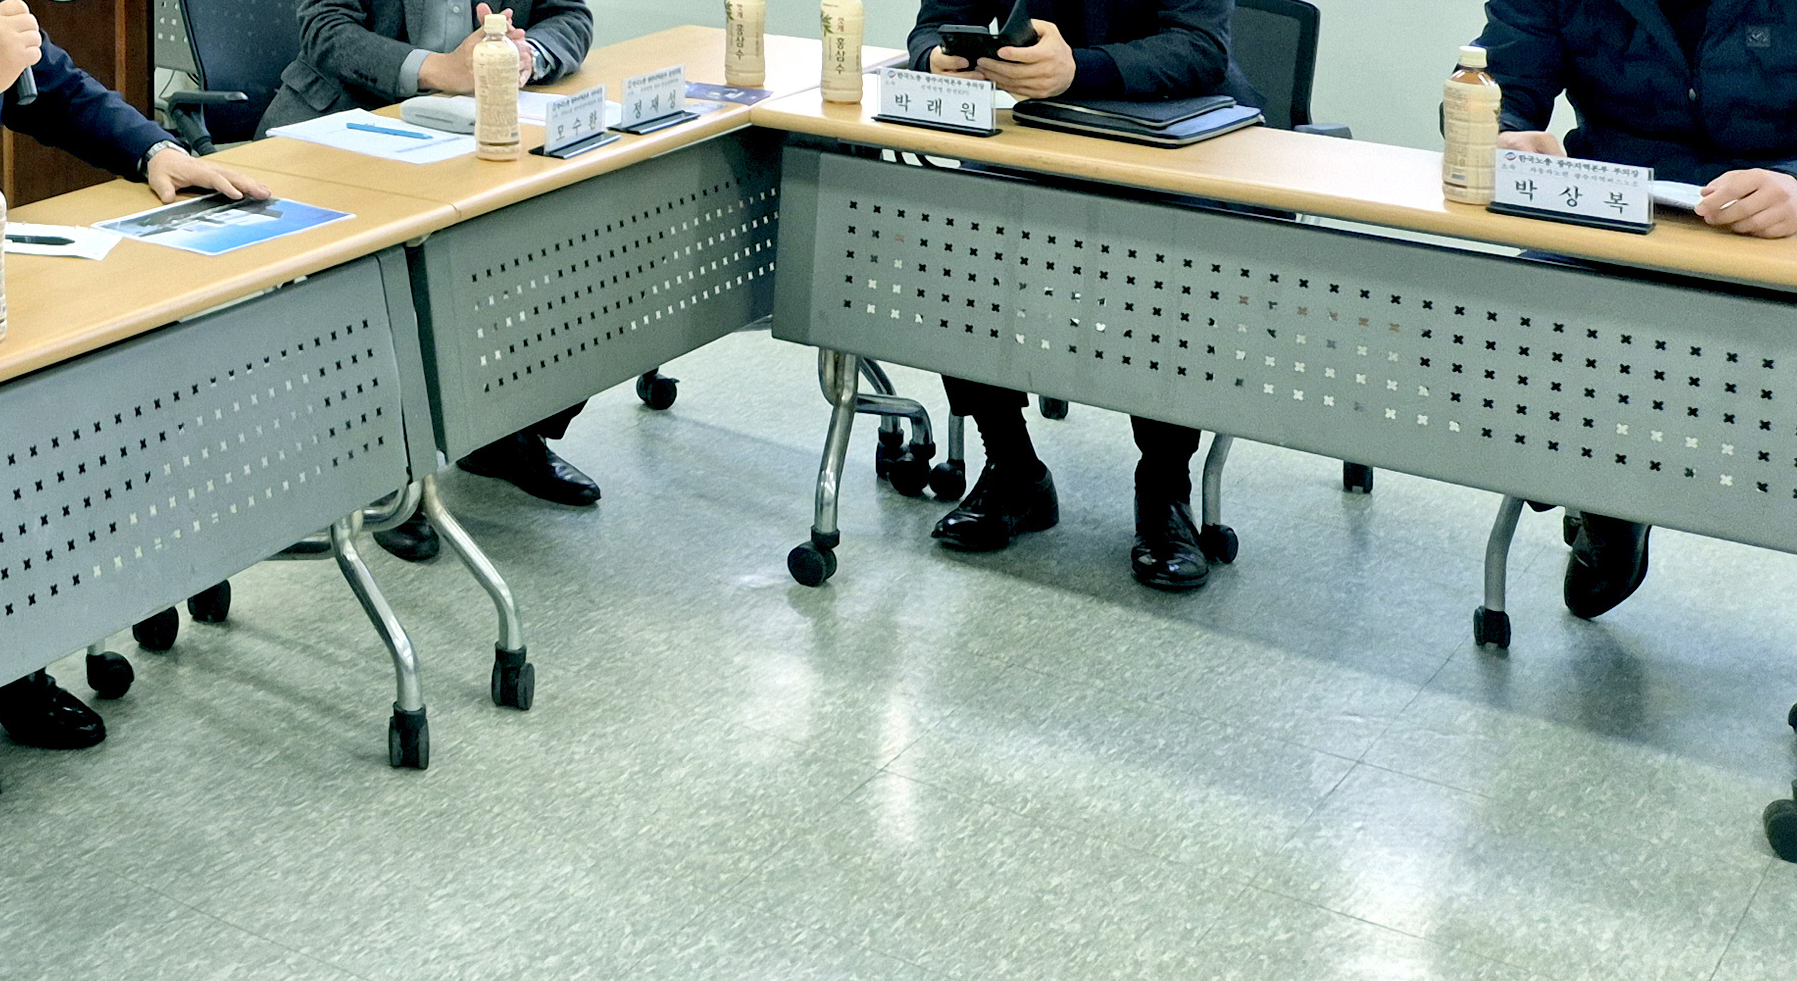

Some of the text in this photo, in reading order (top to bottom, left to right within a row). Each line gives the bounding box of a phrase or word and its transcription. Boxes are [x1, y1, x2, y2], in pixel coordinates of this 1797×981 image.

[1518, 154, 1639, 178] 한국노총 광주지역본부 부의장
